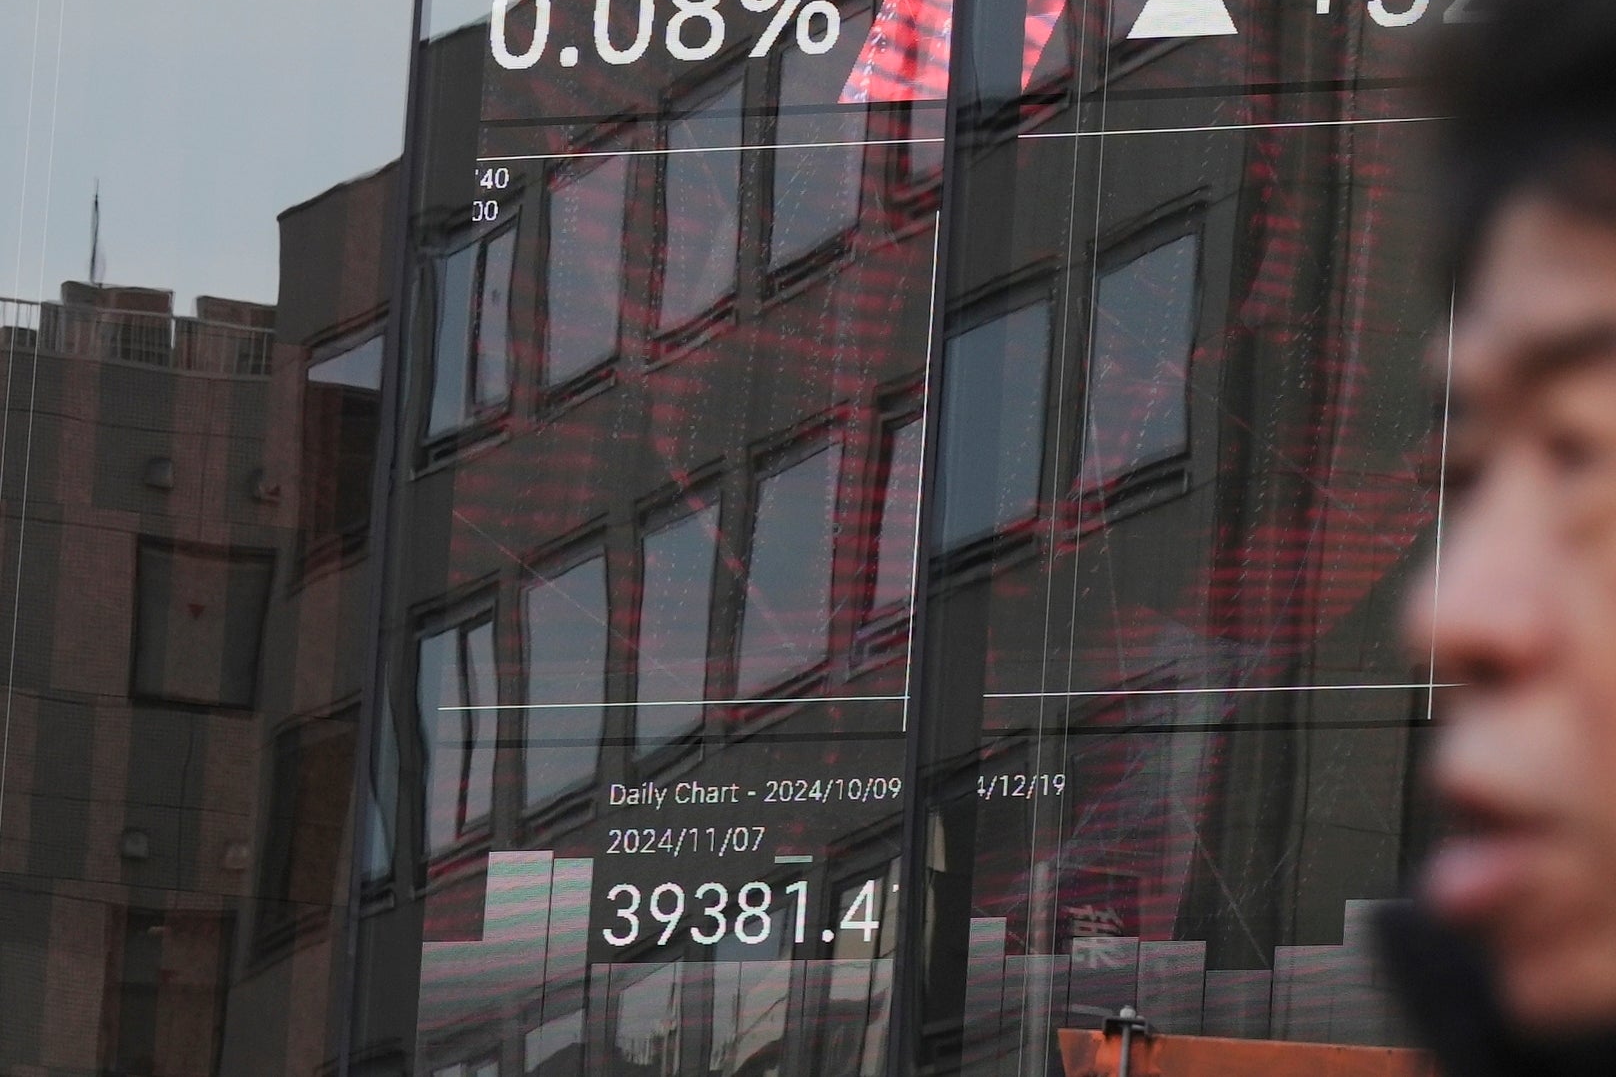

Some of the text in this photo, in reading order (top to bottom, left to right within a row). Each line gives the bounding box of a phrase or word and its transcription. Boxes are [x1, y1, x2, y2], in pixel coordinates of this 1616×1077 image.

[609, 782, 666, 810] Daily
[675, 781, 740, 805] Chart
[764, 776, 902, 805] 2024/10/09
[606, 825, 766, 857] 2024/11/07
[602, 879, 900, 947] 39381.4
